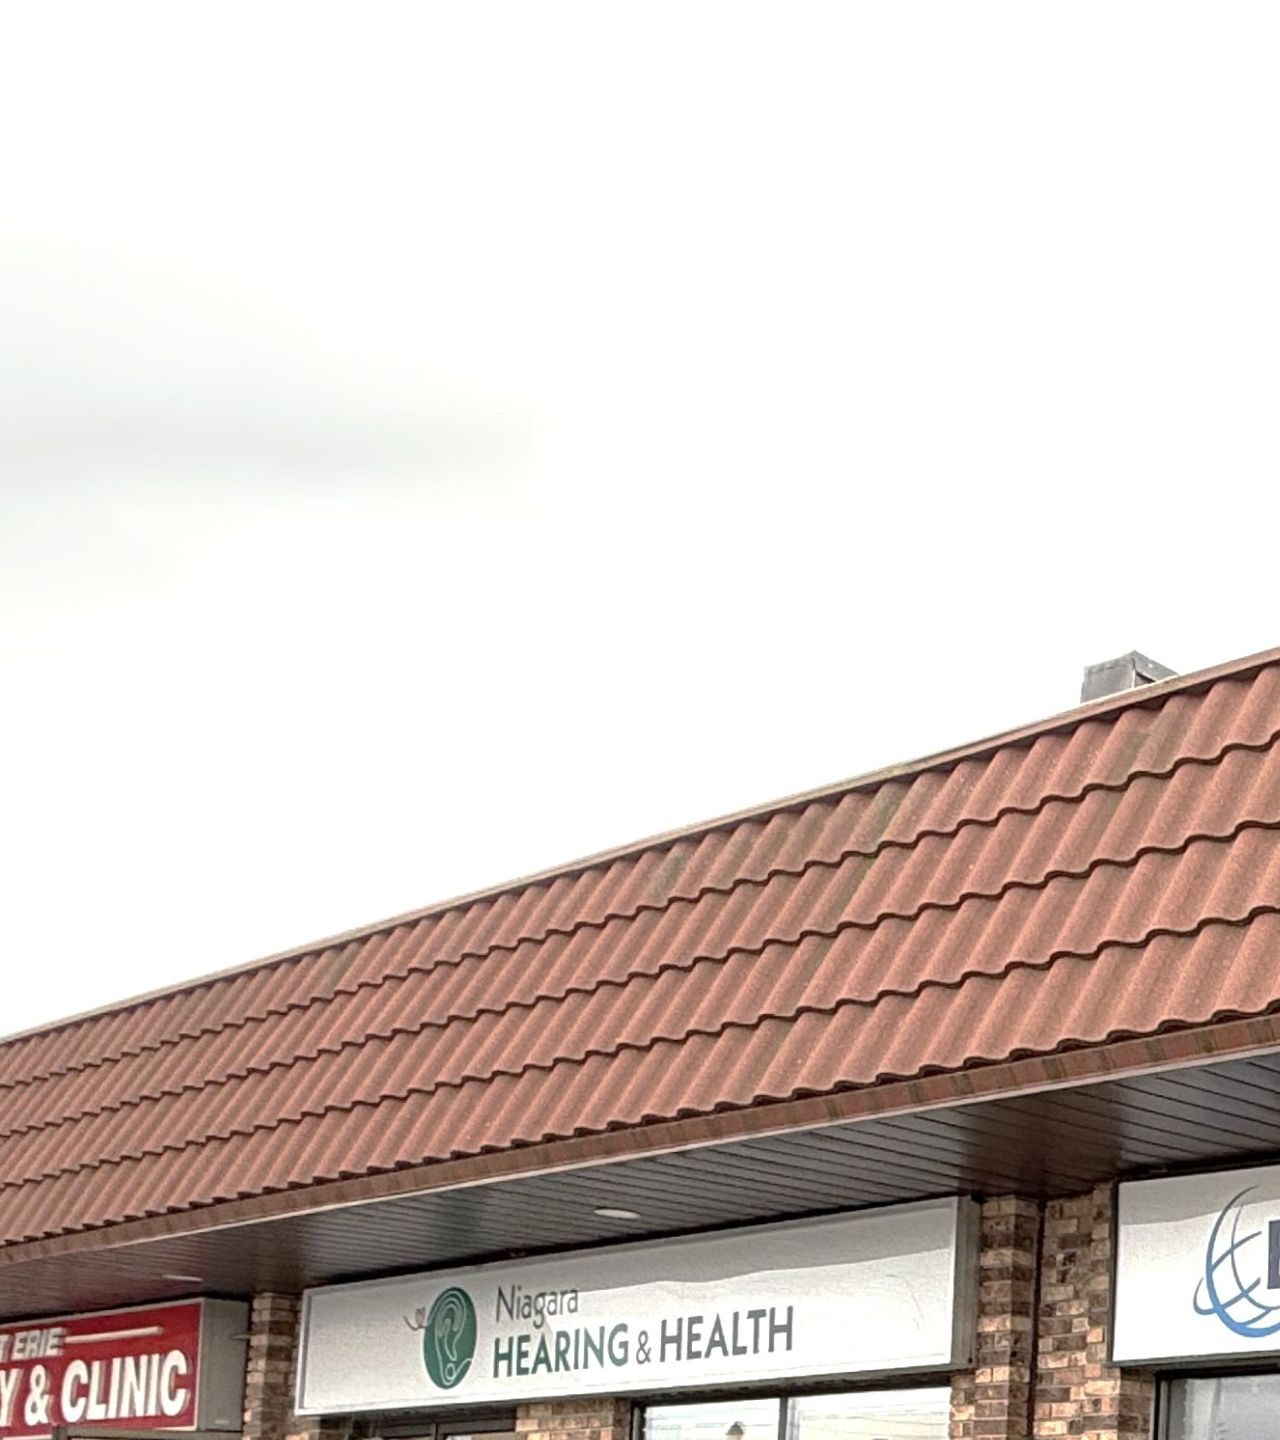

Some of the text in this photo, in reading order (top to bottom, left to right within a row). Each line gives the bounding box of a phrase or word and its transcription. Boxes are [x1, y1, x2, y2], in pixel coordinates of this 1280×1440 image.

[496, 1285, 580, 1328] Niagara
[11, 1327, 65, 1361] ERIE
[493, 1305, 794, 1379] HEARING & HEALTH
[61, 1349, 189, 1423] CLINIC
